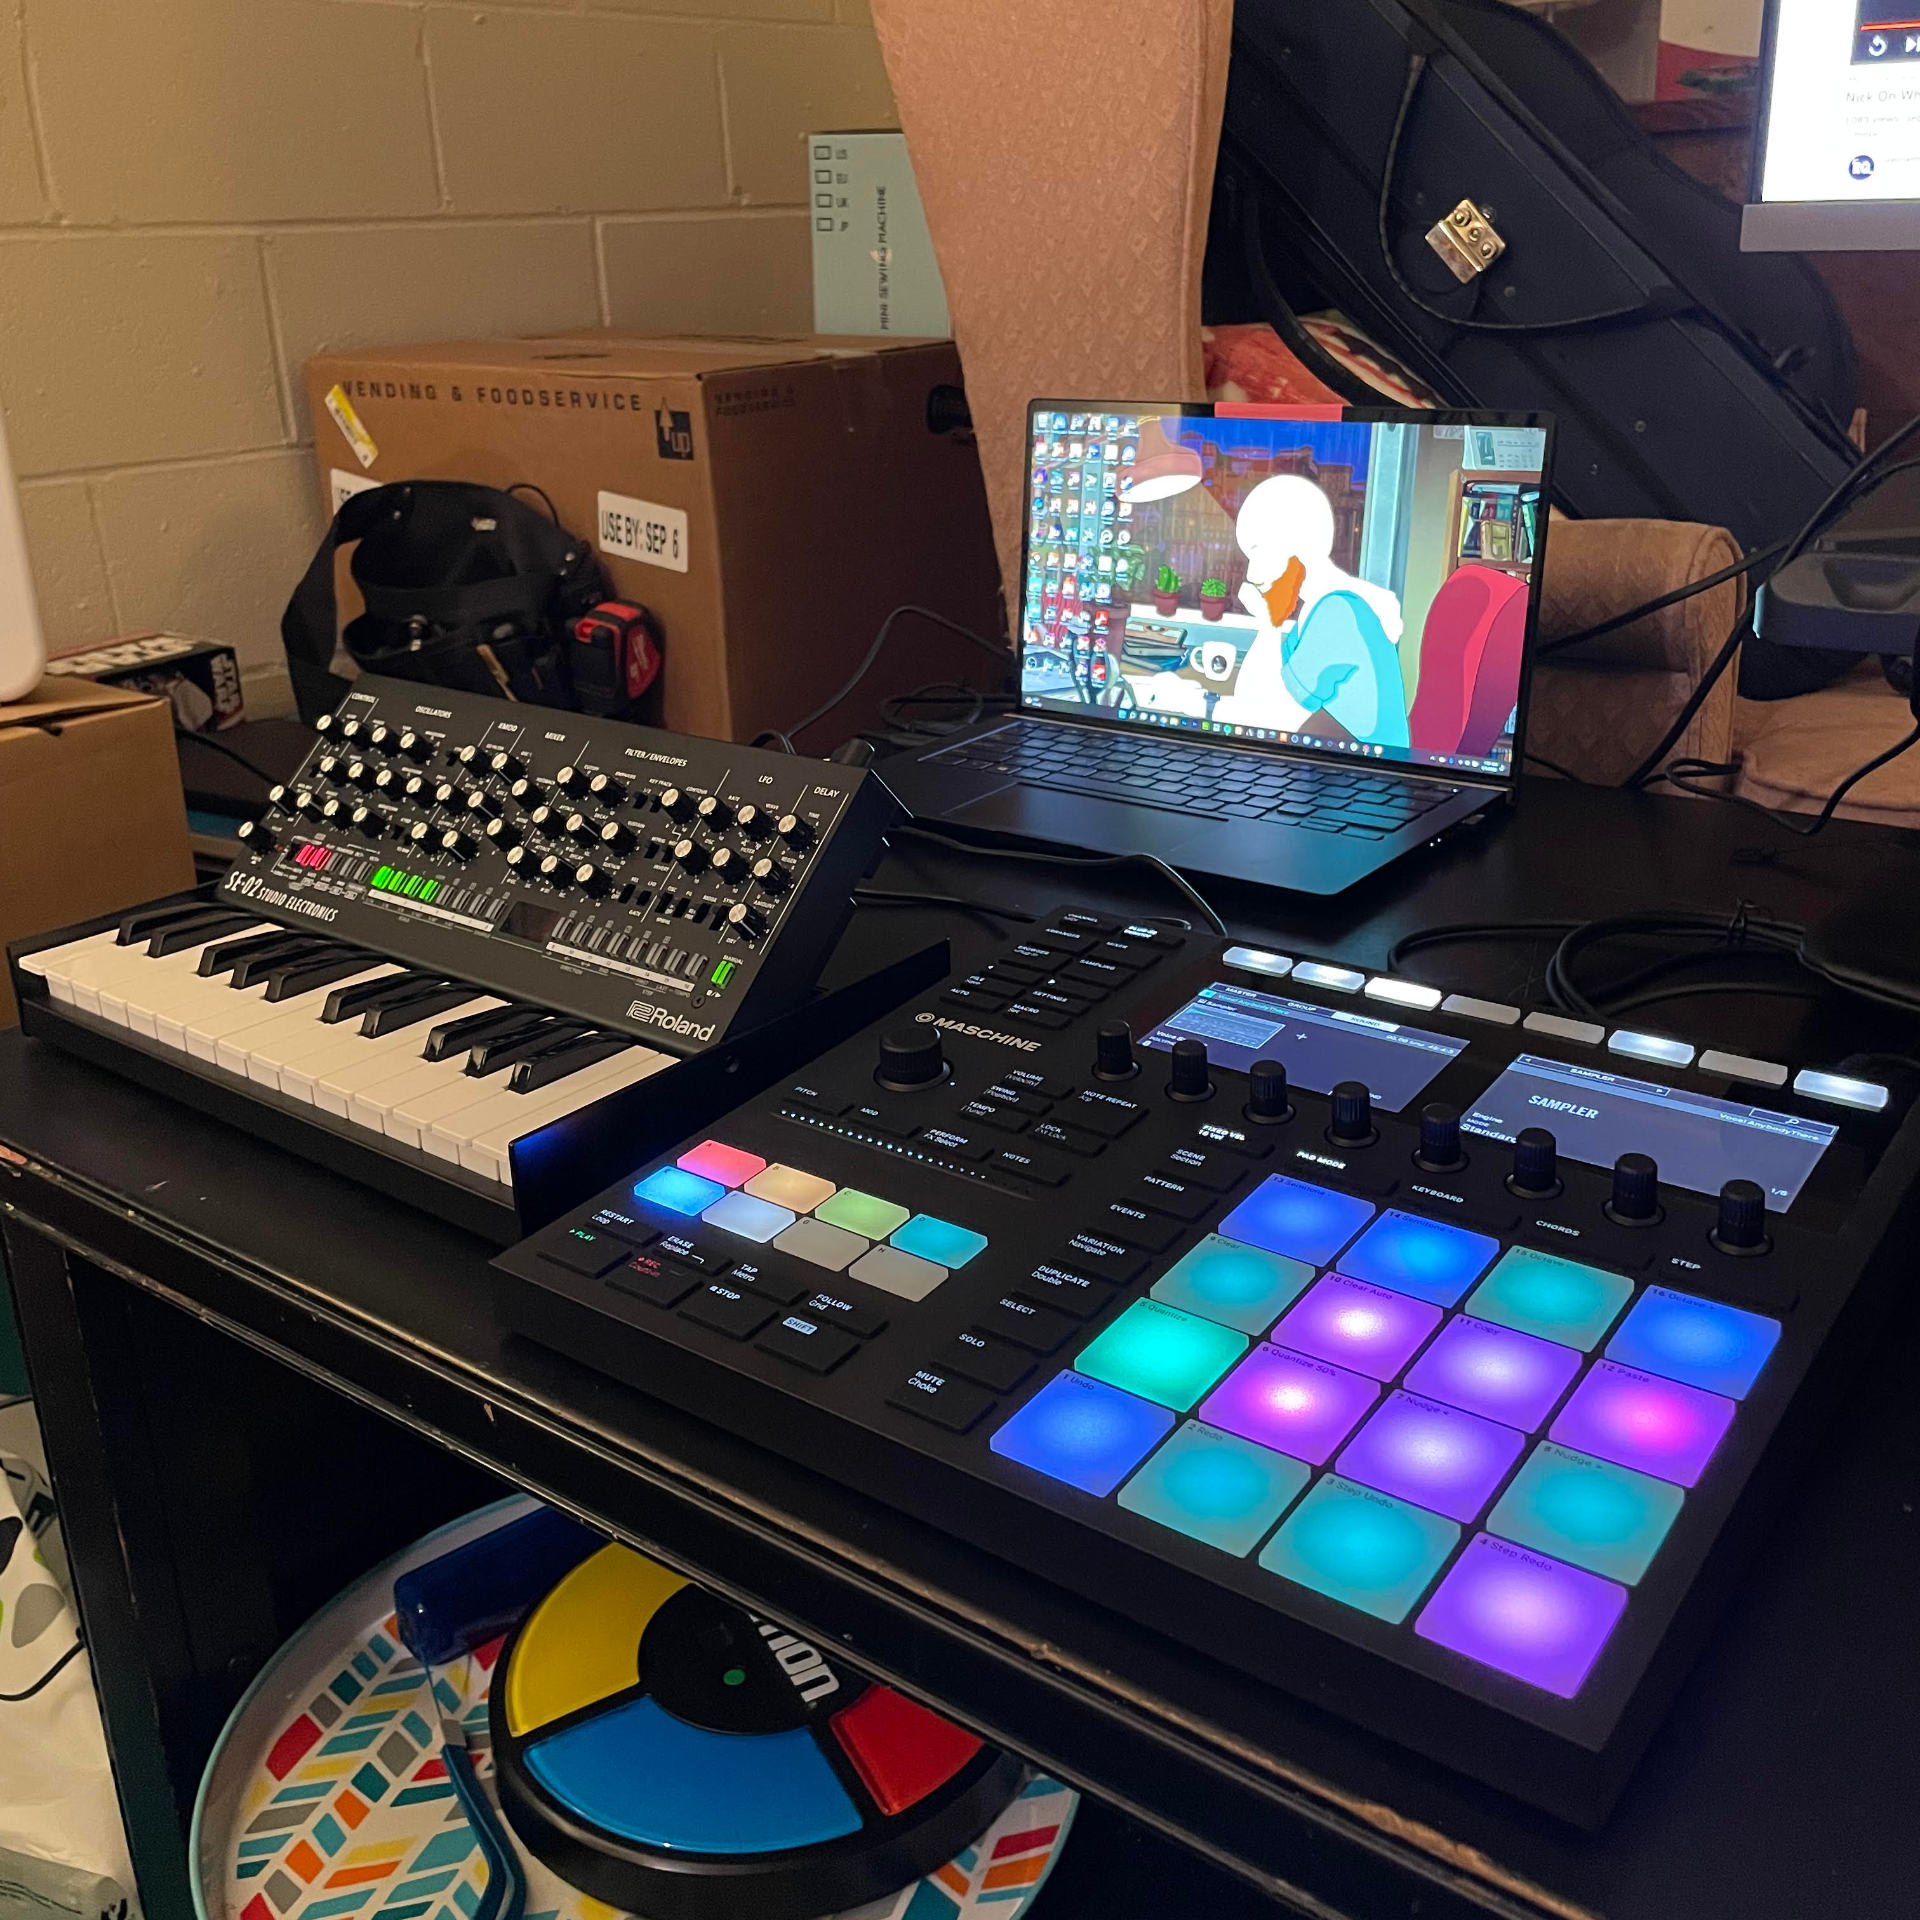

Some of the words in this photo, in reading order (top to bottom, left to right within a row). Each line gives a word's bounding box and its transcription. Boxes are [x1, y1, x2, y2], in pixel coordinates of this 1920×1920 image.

[1846, 92, 1873, 103] Nick
[1879, 90, 1896, 102] On
[875, 185, 888, 244] MACHINE
[877, 246, 890, 299] SEWING
[880, 303, 890, 331] MINI
[343, 381, 436, 400] VENDING
[452, 386, 462, 401] &
[476, 387, 643, 411] FOODSERVICE
[601, 510, 622, 546] USE
[625, 517, 643, 551] BY:
[645, 522, 667, 555] SEP
[672, 530, 679, 560] 6
[624, 748, 688, 767] FILTER/ENVELOPES
[758, 775, 773, 784] LFO
[813, 786, 840, 798] DELAY
[256, 887, 288, 907] STUDIO
[285, 896, 338, 922] ELECTRONICS
[753, 900, 776, 909] AMOUNT
[1079, 959, 1116, 970] SAMPLING
[950, 988, 970, 996] AUTO
[1032, 990, 1068, 1003] SETTINGS
[1225, 987, 1257, 998] MASTER
[1012, 1004, 1040, 1014] MACRO
[1205, 1000, 1238, 1012] Sampler
[1287, 1002, 1317, 1012] GROUP
[649, 1008, 716, 1042] Roland
[932, 1017, 1042, 1052] MASCHINE
[1012, 1069, 1045, 1082] VOLUME
[1570, 1068, 1615, 1082] SAMPLER
[794, 1086, 818, 1097] PITCH
[990, 1085, 1017, 1096] SWING
[969, 1101, 996, 1113] TEMPO
[1083, 1090, 1103, 1100] NOTE
[1105, 1095, 1138, 1109] REPEAT
[1528, 1094, 1599, 1119] SAMPLER
[860, 1107, 879, 1116] MOD
[1472, 1112, 1504, 1124] Engine
[1040, 1123, 1063, 1133] LOCK
[1466, 1118, 1490, 1127] MODE
[1719, 1113, 1746, 1123] Vocal
[1747, 1119, 1820, 1141] AnybodyThere
[930, 1128, 969, 1144] PERFORM
[1198, 1129, 1209, 1137] 16
[1210, 1131, 1225, 1140] Vel
[1202, 1124, 1229, 1136] FIXED
[1229, 1131, 1246, 1141] VEL
[1002, 1152, 1031, 1165] NOTES
[1170, 1153, 1202, 1167] Section
[1175, 1148, 1206, 1161] SCENE
[1296, 1151, 1317, 1161] PAD
[1316, 1156, 1347, 1169] MODE
[1143, 1175, 1185, 1192] PATTERN
[1285, 1181, 1326, 1196] Semitone
[1411, 1185, 1464, 1203] KEYBOARD
[591, 1214, 611, 1225] Loop
[600, 1209, 635, 1225] RESTART
[1110, 1203, 1146, 1220] EVENTS
[1388, 1211, 1400, 1219] 14
[1401, 1214, 1446, 1233] Semitone
[1535, 1220, 1581, 1237] CHORDS
[575, 1230, 597, 1242] PLAY
[667, 1235, 695, 1249] ERASE
[1076, 1233, 1126, 1255] VARIATION
[1217, 1237, 1241, 1250] Clear
[660, 1240, 690, 1256] Replace
[1068, 1239, 1107, 1256] Navigate
[1514, 1248, 1528, 1256] 15
[1529, 1252, 1565, 1267] Octave
[1671, 1257, 1702, 1270] STEP
[731, 1268, 756, 1282] Metro
[740, 1263, 759, 1273] TAP
[1031, 1270, 1062, 1286] Double
[1037, 1265, 1091, 1288] DUPLICATE
[715, 1287, 741, 1301] STOP
[1329, 1275, 1342, 1283] 10
[1342, 1279, 1368, 1293] Clear
[1369, 1287, 1393, 1300] Auto
[808, 1299, 829, 1311] Grid
[815, 1293, 853, 1311] FOLLOW
[999, 1298, 1037, 1315] SELECT
[1652, 1288, 1665, 1297] 16
[1667, 1293, 1706, 1309] Octave
[1147, 1303, 1189, 1322] Quantize
[786, 1318, 816, 1332] SHIFT
[1474, 1321, 1501, 1336] Copy
[959, 1333, 986, 1348] SOLO
[1270, 1348, 1315, 1369] Quantize
[1315, 1364, 1337, 1377] 50%
[915, 1370, 946, 1387] MUTE
[1601, 1362, 1615, 1372] 12
[1617, 1367, 1650, 1383] Paste
[908, 1377, 938, 1394] Choke
[1071, 1375, 1095, 1391] Undo
[1406, 1397, 1440, 1414] Nudge
[1197, 1427, 1223, 1442] Redo
[1554, 1448, 1592, 1469] Nudge
[1325, 1478, 1335, 1486] 3
[1336, 1482, 1362, 1497] Step
[1364, 1493, 1393, 1509] Undo
[1478, 1538, 1487, 1546] 4
[1489, 1541, 1518, 1559] Step
[1520, 1554, 1552, 1571] Redo
